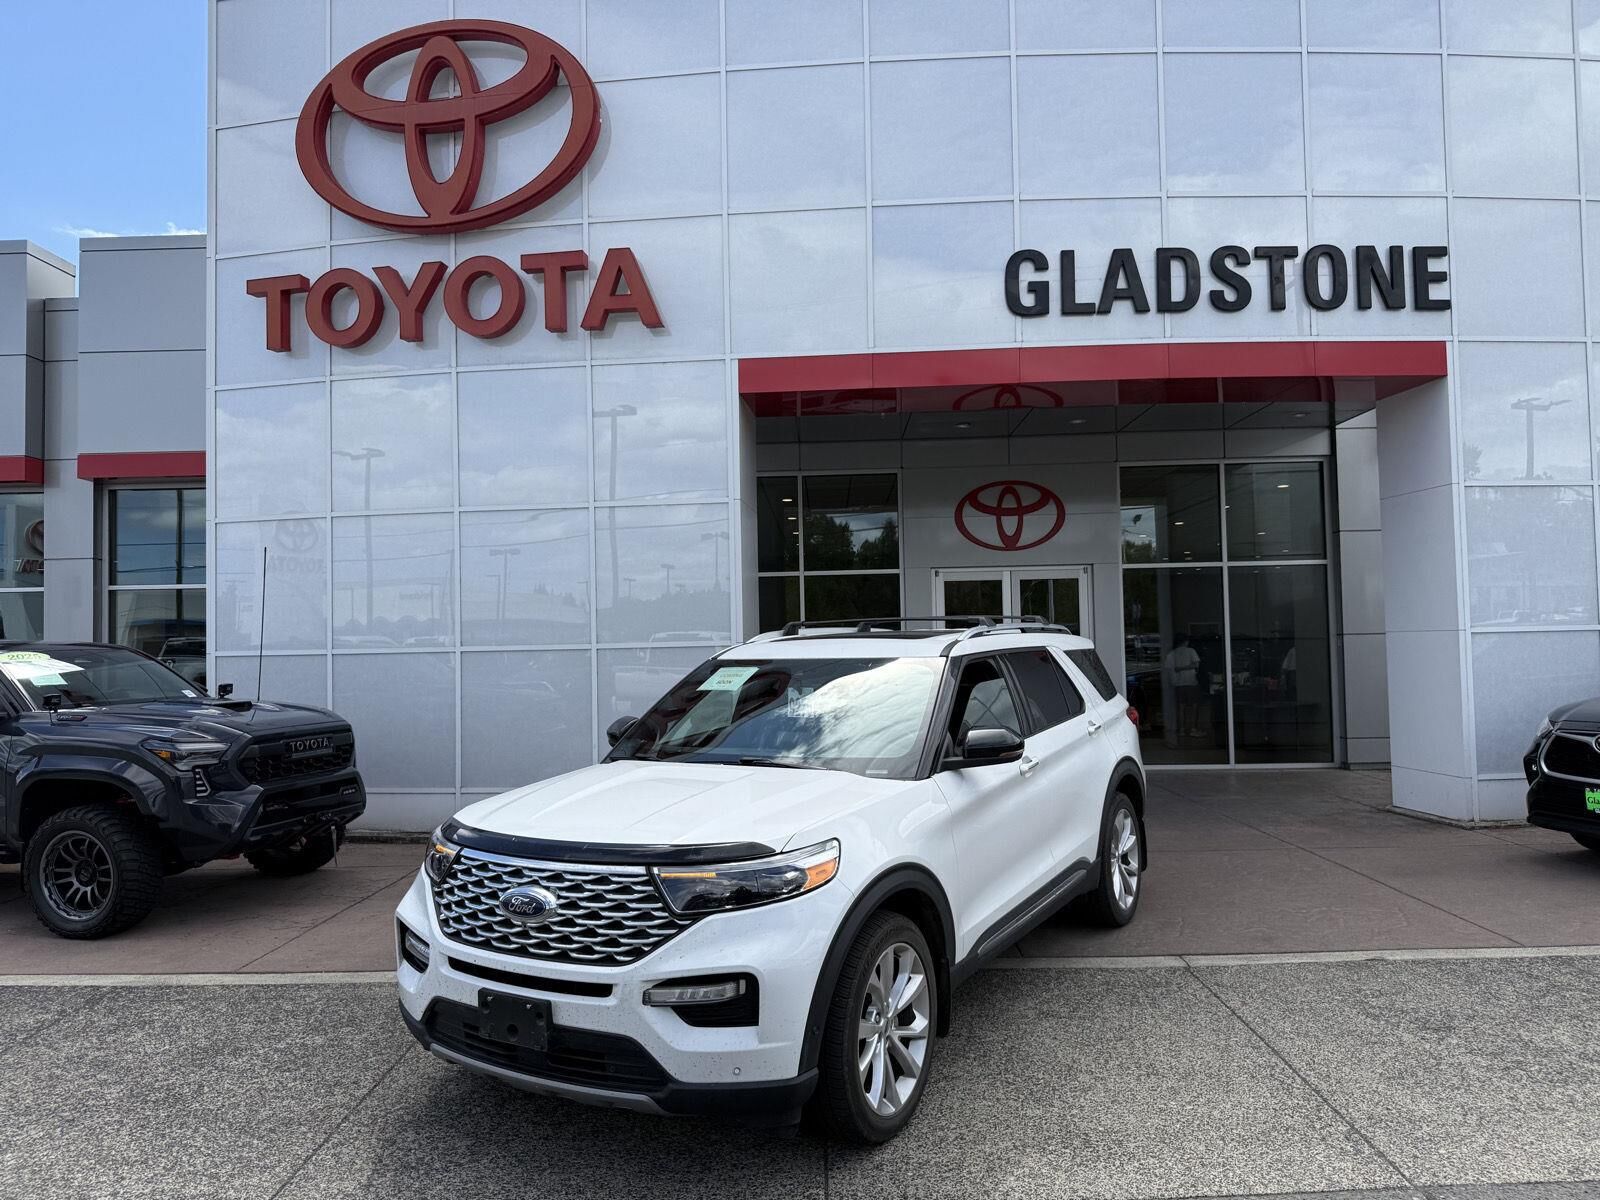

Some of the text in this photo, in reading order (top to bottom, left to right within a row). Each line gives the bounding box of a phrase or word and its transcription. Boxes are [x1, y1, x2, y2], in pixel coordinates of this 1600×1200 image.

[246, 247, 665, 352] TOYOTA
[1004, 244, 1451, 317] GLADSTONE
[290, 737, 330, 752] TOYOTA
[508, 895, 537, 914] Ford
